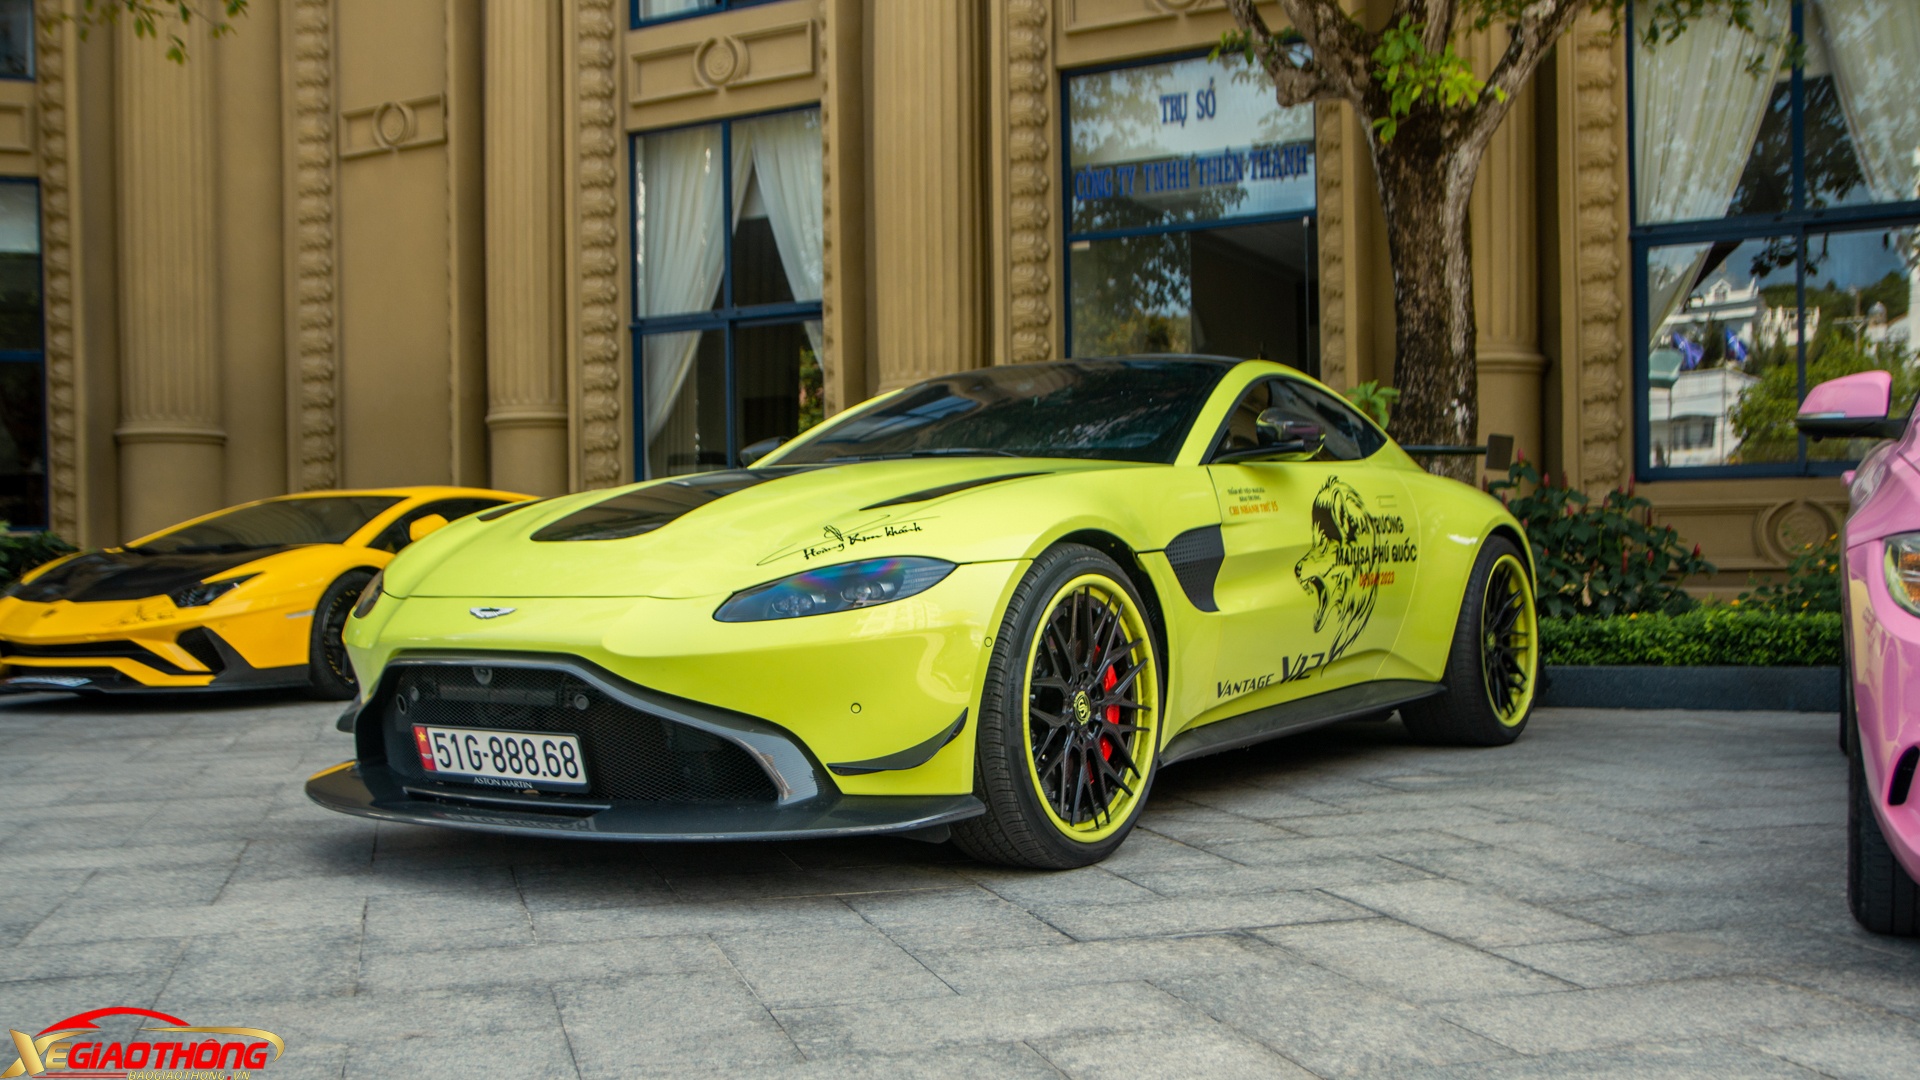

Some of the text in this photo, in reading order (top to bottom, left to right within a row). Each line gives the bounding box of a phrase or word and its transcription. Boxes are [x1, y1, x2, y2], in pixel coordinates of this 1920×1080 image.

[1159, 92, 1188, 127] TRỤ
[1075, 163, 1112, 200] CÔNG
[1117, 164, 1136, 197] TY
[1143, 159, 1189, 192] TNHH
[1196, 146, 1244, 187] THIÊN
[1217, 673, 1275, 698] VANTAGE
[432, 732, 579, 779] 51G-888.68
[473, 776, 533, 789] ASTON MARTIN
